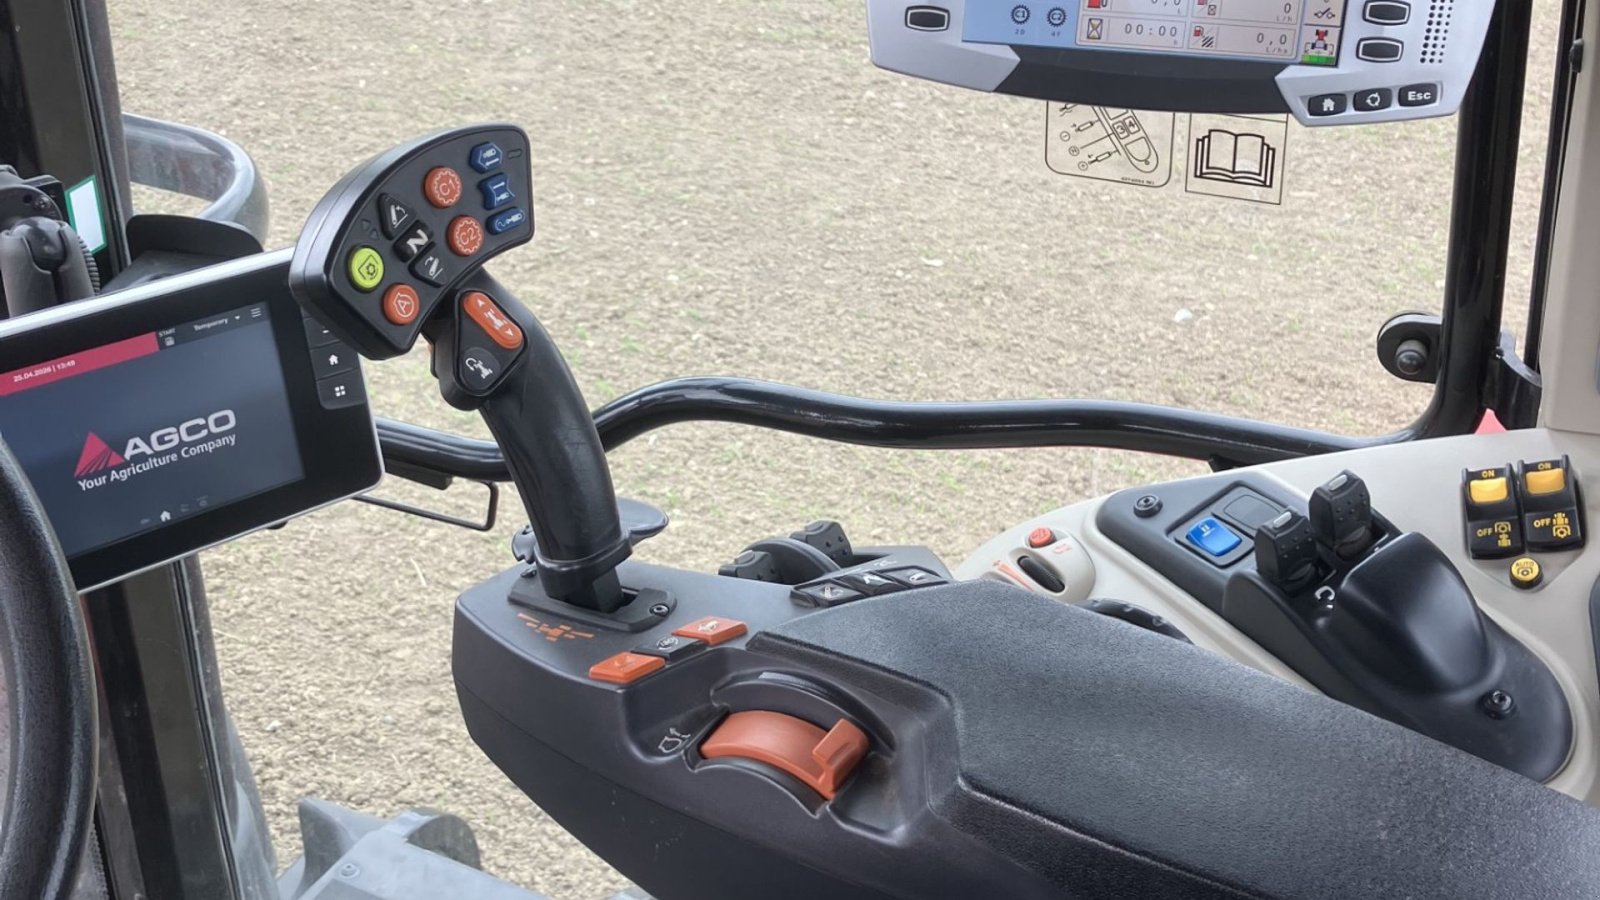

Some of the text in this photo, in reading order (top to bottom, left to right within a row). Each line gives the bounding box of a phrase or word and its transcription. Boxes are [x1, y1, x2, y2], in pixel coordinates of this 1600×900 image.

[1014, 9, 1027, 19] C1
[1283, 3, 1292, 14] 0
[1050, 12, 1063, 21] C2
[1124, 23, 1177, 37] 00:00
[1256, 32, 1287, 45] 0,0
[1407, 91, 1432, 101] Esc
[1116, 124, 1125, 134] 3
[440, 179, 455, 196] C1
[406, 228, 429, 255] N
[459, 228, 477, 247] C2
[193, 318, 229, 331] Temporary
[123, 409, 236, 461] AGCO
[78, 434, 236, 491] Your Agriculture Company
[1537, 462, 1552, 470] ON
[1481, 470, 1495, 478] ON
[1533, 517, 1551, 528] OFF
[1476, 527, 1493, 537] OFF
[1515, 560, 1535, 568] AUTO
